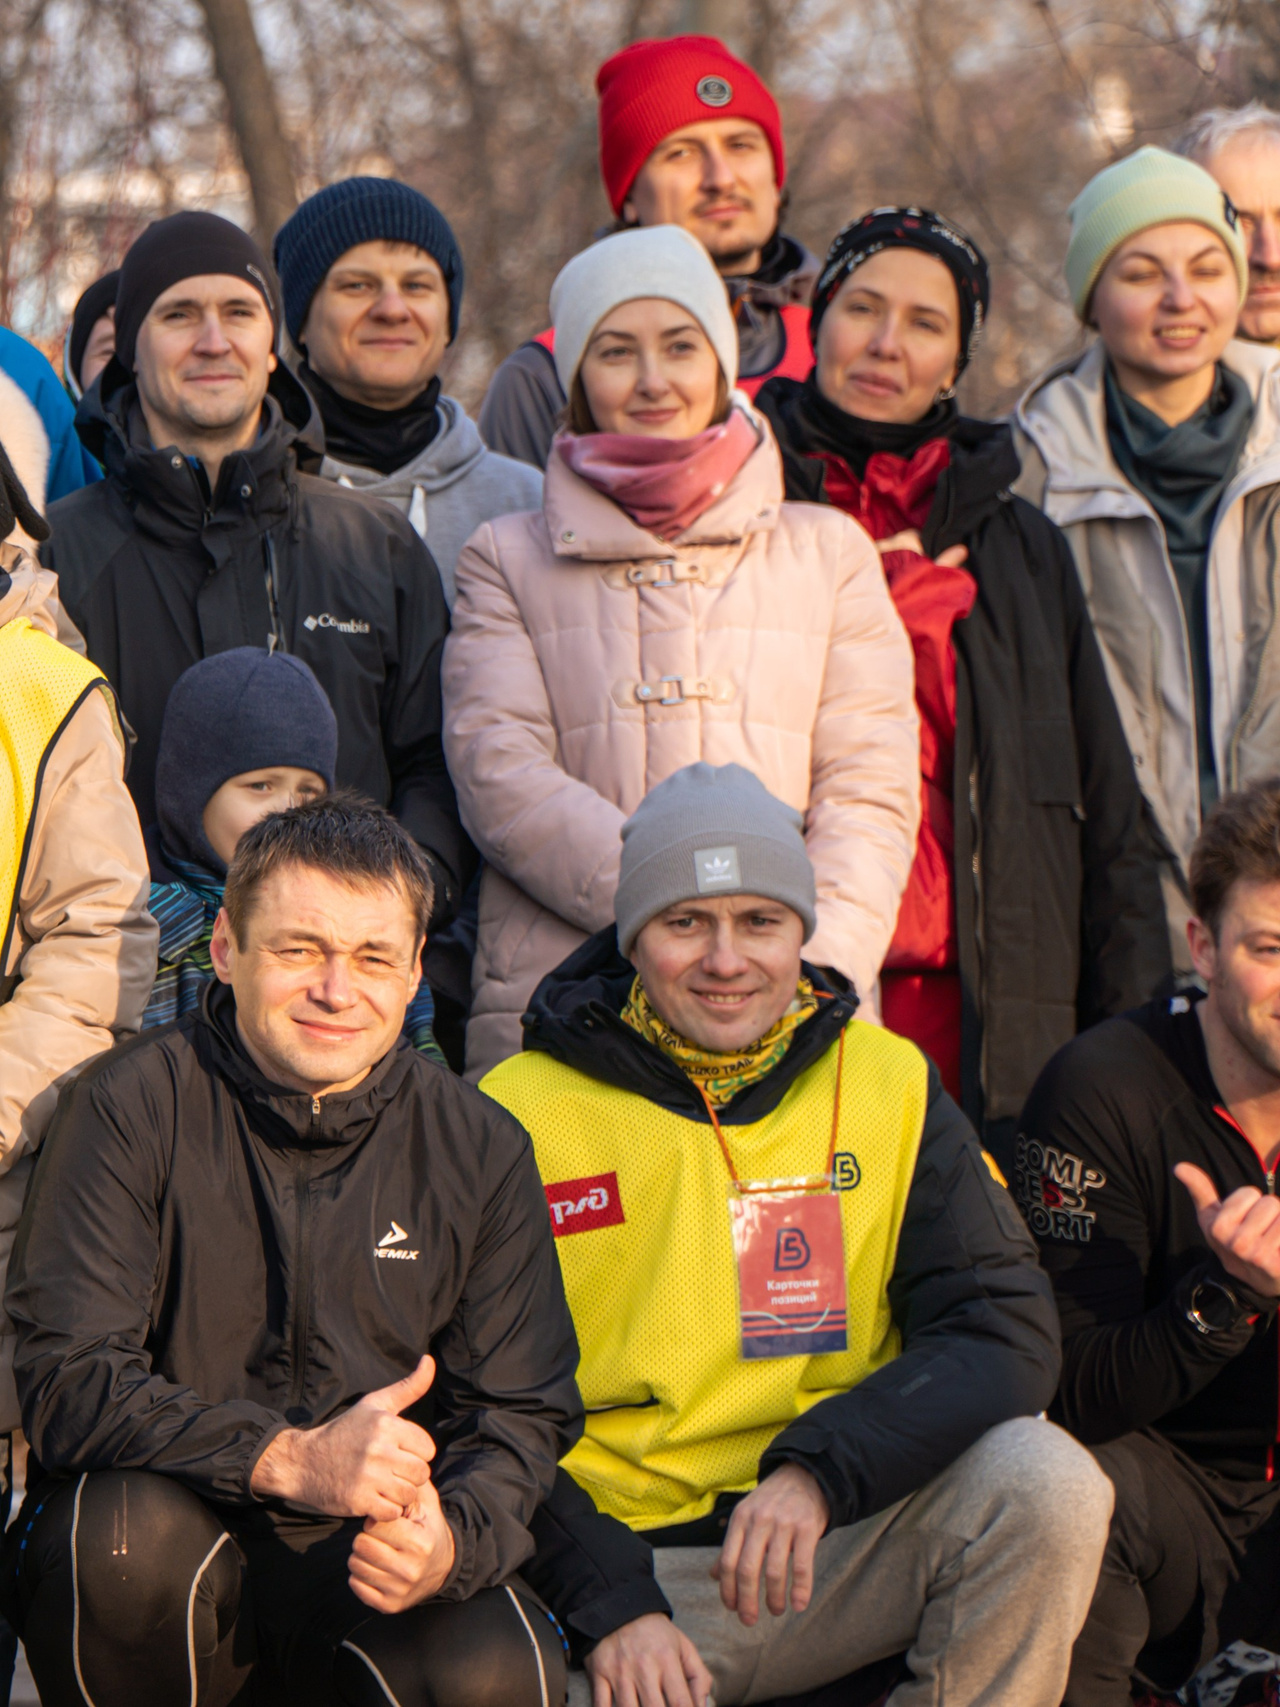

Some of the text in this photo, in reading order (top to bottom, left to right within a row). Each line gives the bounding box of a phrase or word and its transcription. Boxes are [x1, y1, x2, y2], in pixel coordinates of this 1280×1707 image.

[723, 1057, 754, 1075] TRAIL
[766, 1279, 819, 1293] Карточки
[771, 1292, 817, 1305] позиций
